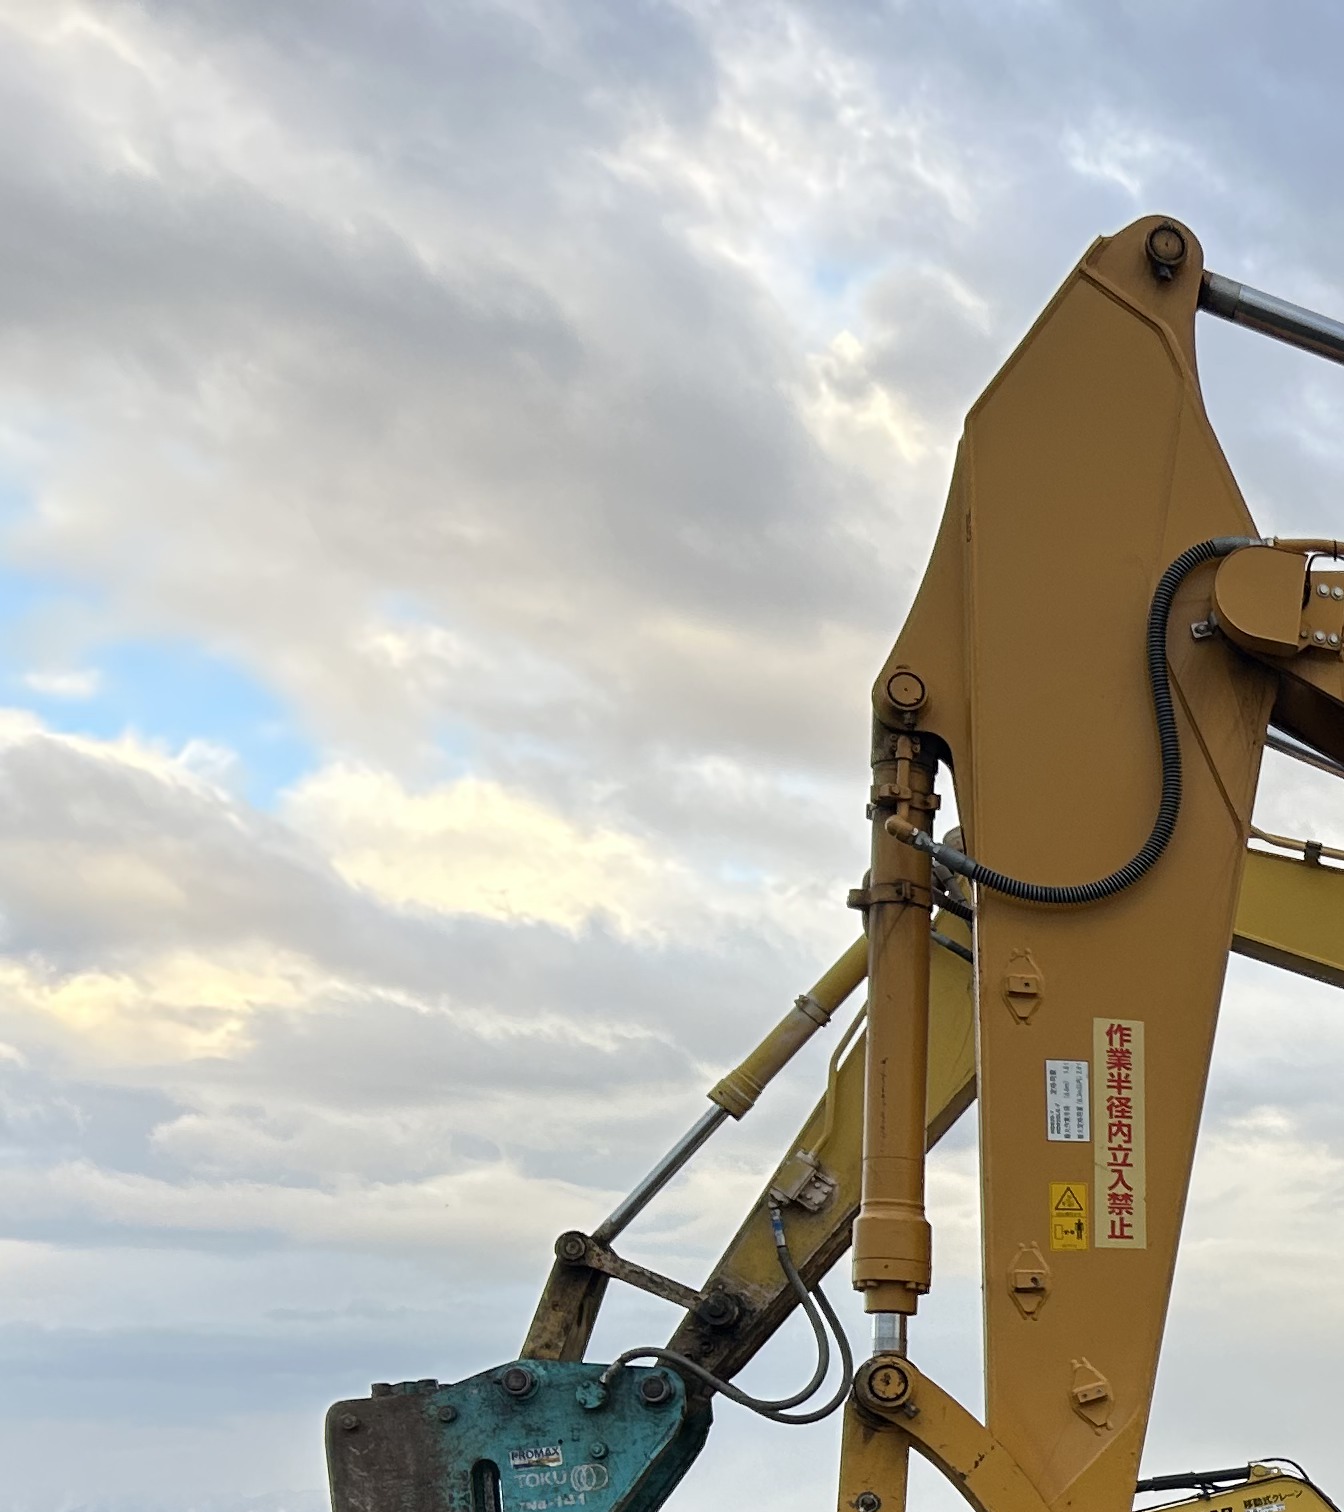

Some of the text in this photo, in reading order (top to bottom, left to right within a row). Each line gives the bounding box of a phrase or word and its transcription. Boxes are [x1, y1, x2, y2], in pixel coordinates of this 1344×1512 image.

[1105, 1023, 1134, 1240] 作業半径内立入禁止
[511, 1447, 560, 1460] PROMAX
[514, 1470, 567, 1488] TOKU
